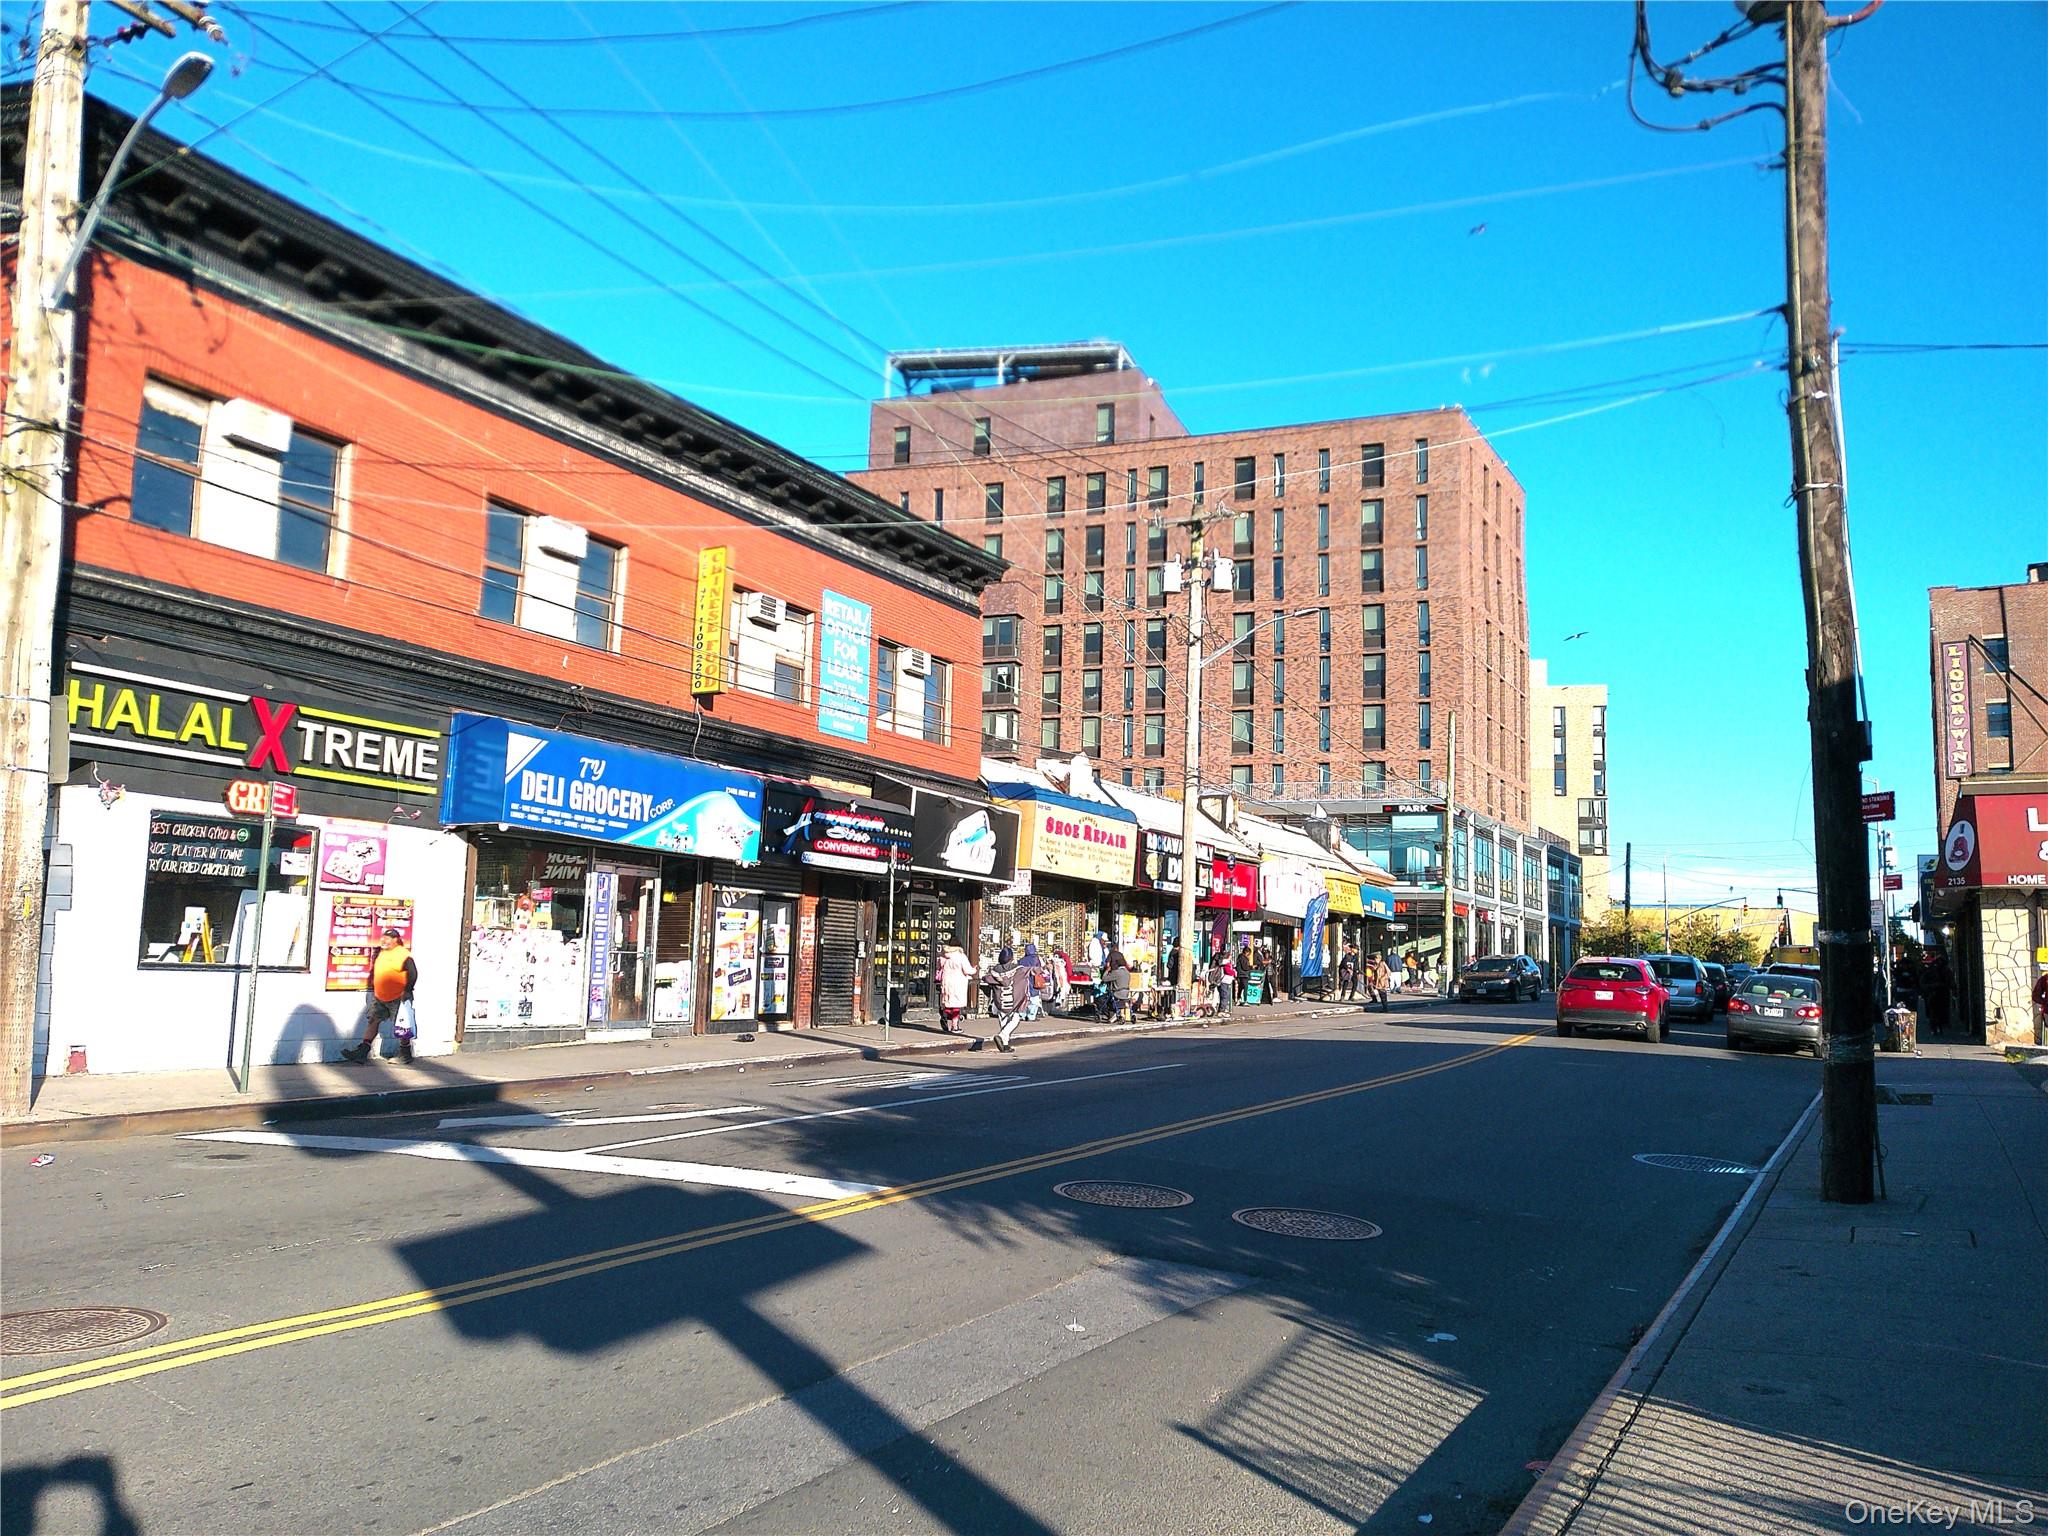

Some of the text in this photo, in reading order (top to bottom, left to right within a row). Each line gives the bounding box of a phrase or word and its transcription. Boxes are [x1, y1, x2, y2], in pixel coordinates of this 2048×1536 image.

[825, 618, 868, 647] OFFICE
[834, 640, 858, 663] FOR
[827, 656, 864, 685] LEASE
[1948, 646, 1966, 714] LIQUOR
[69, 678, 248, 752] HALAL
[1950, 729, 1969, 774] WINE
[579, 757, 607, 781] TY
[520, 769, 566, 807] DELI
[569, 780, 654, 823] GROCERY
[650, 798, 677, 819] CORP.
[1398, 804, 1428, 813] PARK
[171, 823, 208, 838] CHICKEN
[1046, 816, 1080, 839] SHOE
[1083, 824, 1127, 850] REPAIR
[171, 843, 208, 858] PLATTER
[816, 840, 878, 857] CONVENIENCE
[1948, 877, 1966, 886] 2135
[2007, 874, 2047, 885] HOME
